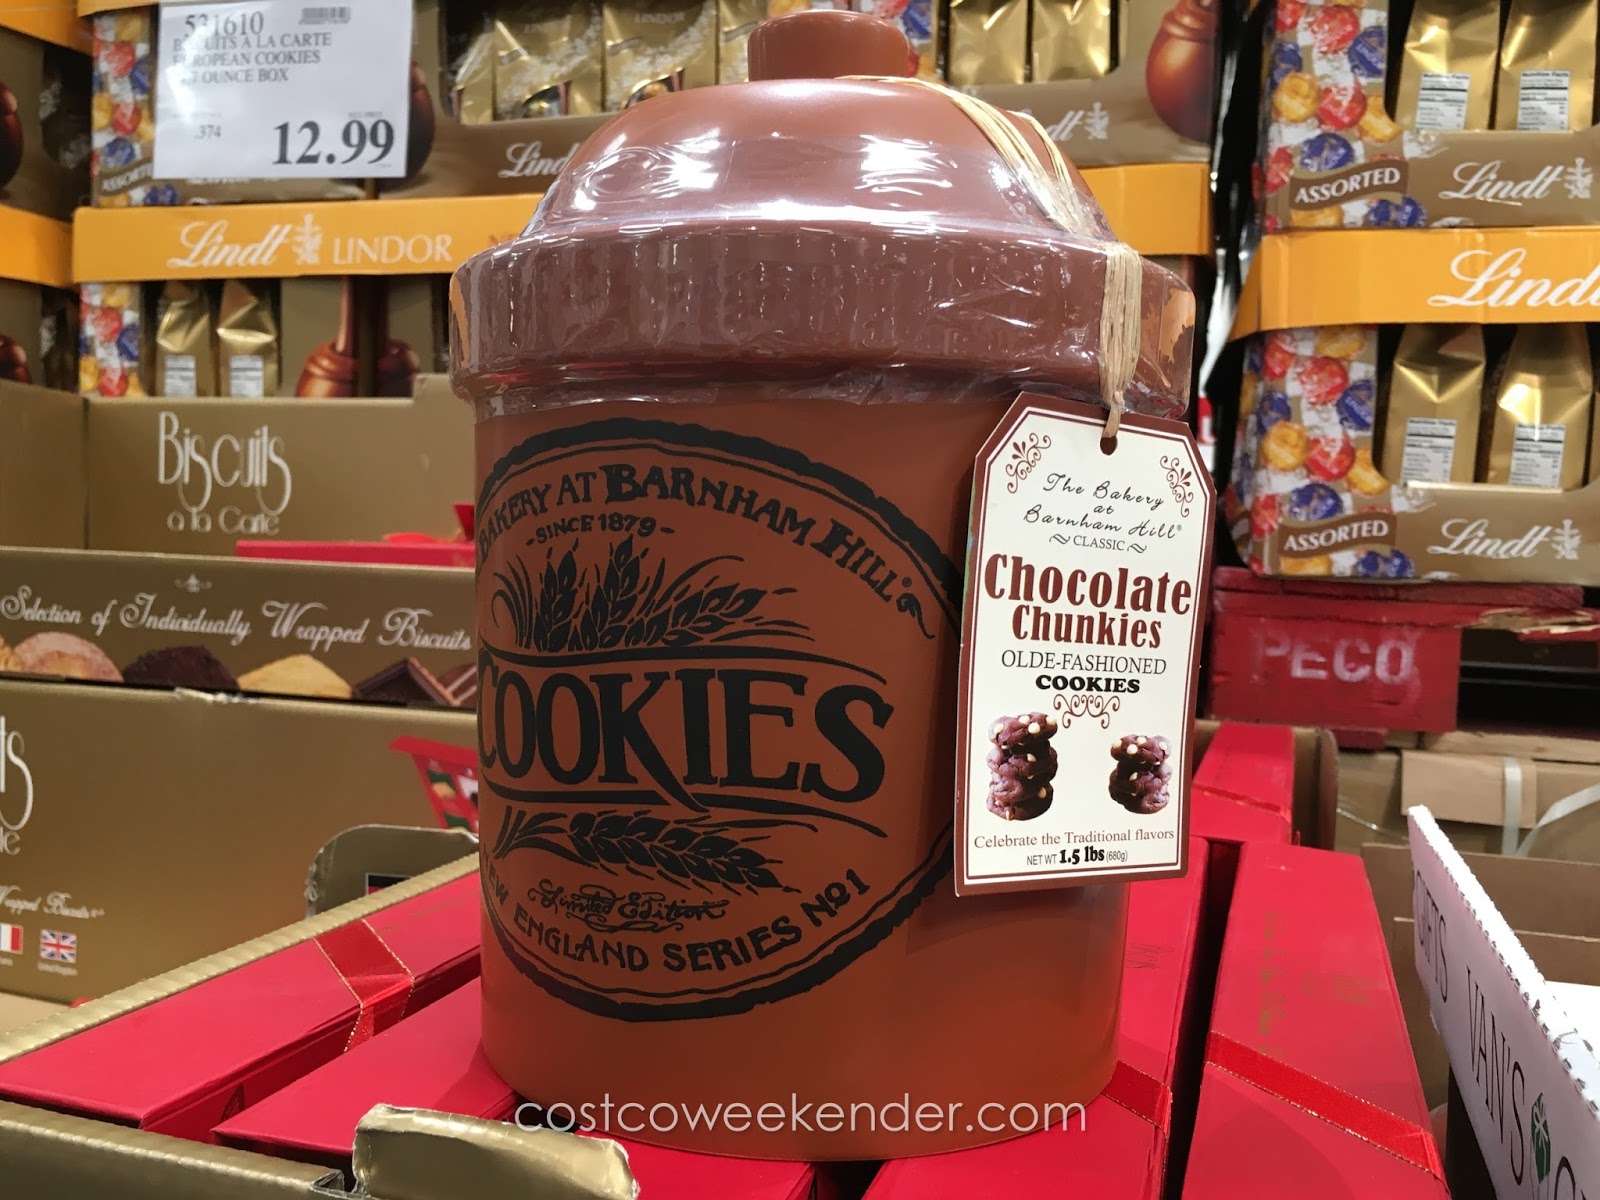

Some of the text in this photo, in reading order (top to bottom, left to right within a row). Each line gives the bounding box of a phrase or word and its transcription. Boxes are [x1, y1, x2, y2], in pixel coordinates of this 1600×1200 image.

[172, 50, 321, 67] EROPEAN COOKIES
[173, 35, 237, 51] BUITS
[256, 35, 276, 48] LA
[280, 32, 332, 48] CARTE
[202, 69, 254, 83] OUNCE
[259, 68, 289, 82] BOX
[272, 119, 394, 165] 12.99
[497, 141, 580, 178] Lind
[1295, 167, 1400, 204] ASSORTED
[1438, 161, 1565, 200] Lindt
[167, 220, 452, 268] Lindt LINDOR
[1427, 248, 1600, 308] Lind
[158, 410, 292, 516] Biscuits
[1043, 473, 1165, 511] The Bakery
[1093, 505, 1115, 514] at
[190, 506, 212, 533] la
[477, 484, 552, 563] BAKERY
[555, 471, 597, 506] AT
[599, 463, 817, 546] BARNHAM
[1023, 504, 1121, 532] Barnham
[1073, 535, 1126, 552] CLASSIC
[1283, 519, 1389, 551] ASSORTED
[1427, 518, 1552, 559] Lindt
[984, 553, 1192, 615] Chocolate
[0, 585, 472, 652] Selection of Individually Wrapped Biscuits
[1012, 605, 1162, 649] Chunkies
[1001, 650, 1167, 675] OLDE-FASHIONED
[1251, 628, 1415, 685] PECO
[1035, 675, 1140, 693] COOKIES
[477, 650, 895, 812] COOKIES
[974, 829, 1175, 848] Celebrate the Traditional flavors
[1026, 846, 1128, 866] NET WT 1.5 lbs (680g)
[527, 878, 730, 922] Limited Edition
[513, 902, 649, 972] ENGLAND
[662, 915, 803, 973] SERIES
[1467, 965, 1525, 1186] VAN'S
